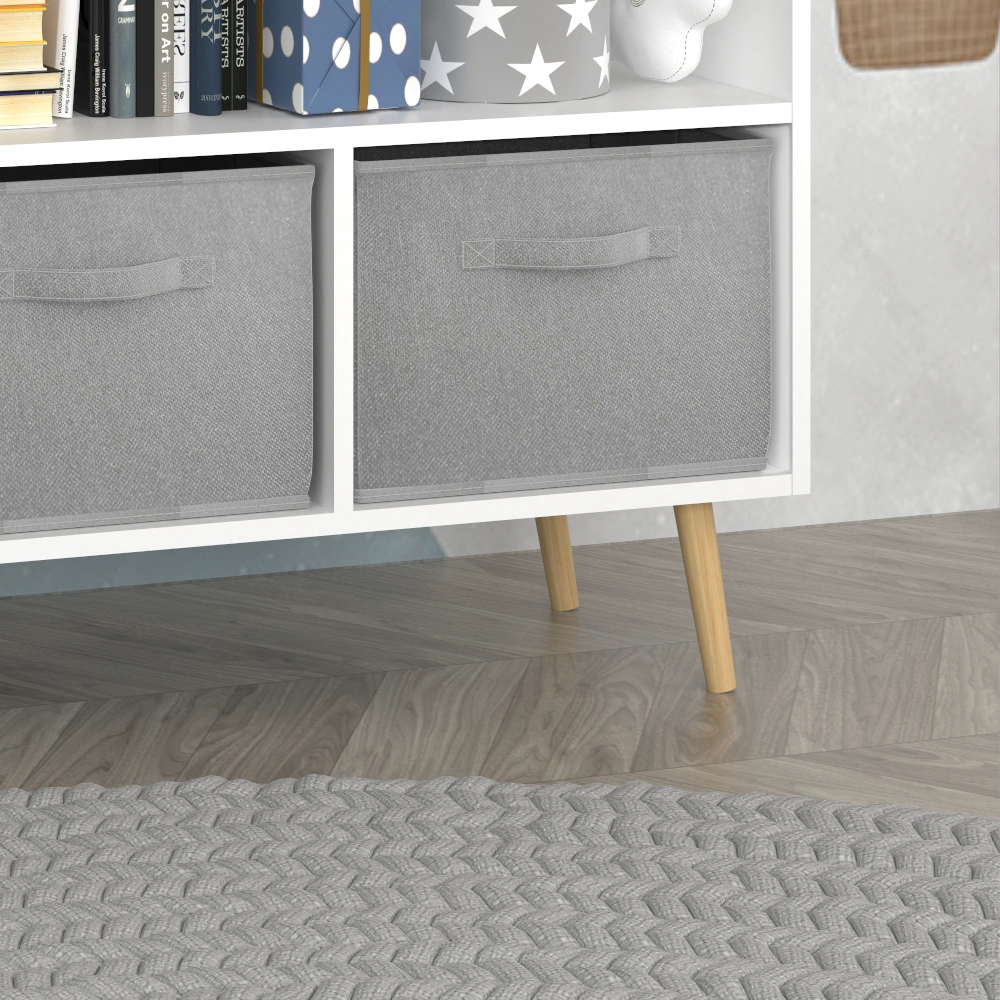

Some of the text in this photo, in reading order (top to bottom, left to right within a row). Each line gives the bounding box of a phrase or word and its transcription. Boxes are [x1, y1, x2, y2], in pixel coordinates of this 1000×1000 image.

[161, 12, 170, 32] on
[161, 37, 171, 63] Art
[57, 87, 65, 114] Bevington
